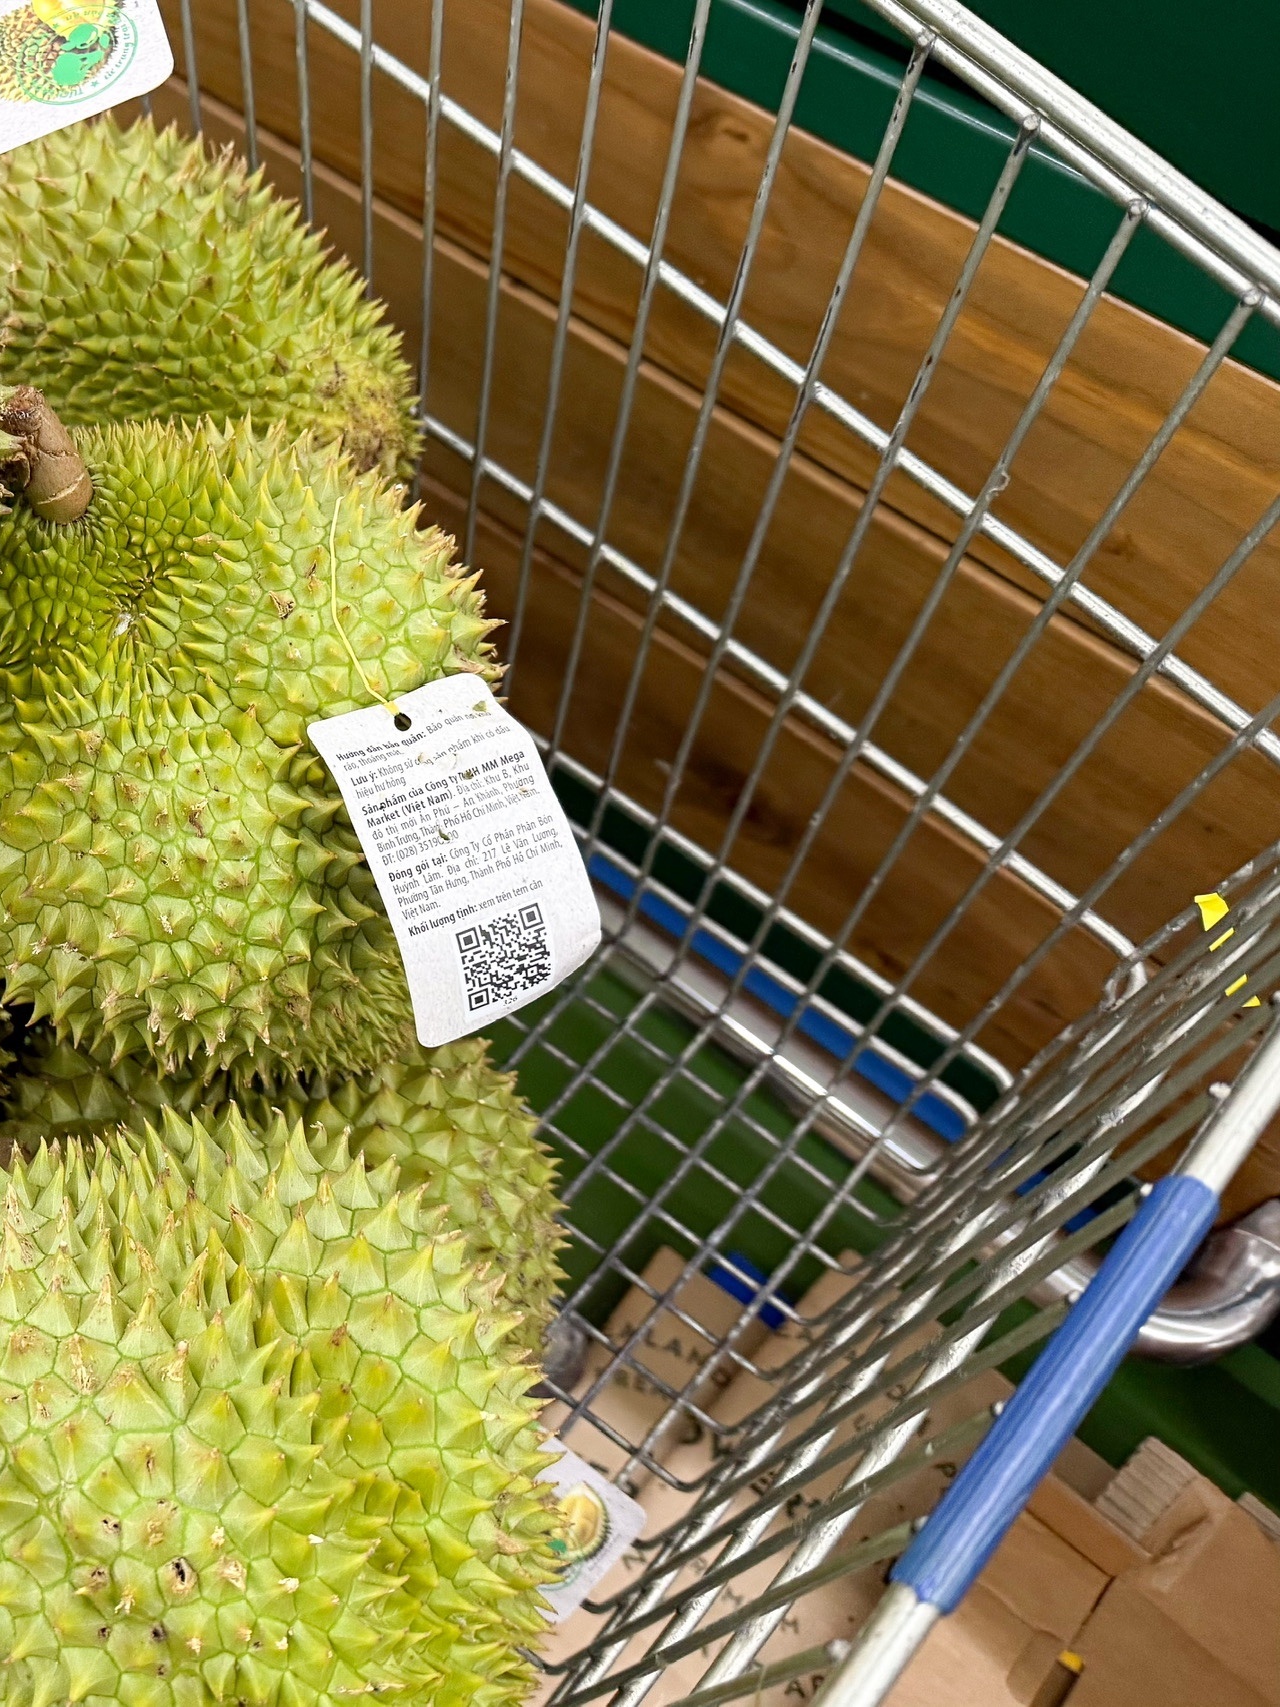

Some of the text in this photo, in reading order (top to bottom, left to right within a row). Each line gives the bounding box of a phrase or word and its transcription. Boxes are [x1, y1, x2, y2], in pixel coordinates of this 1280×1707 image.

[423, 777, 449, 793] Công
[480, 758, 499, 773] MM
[498, 749, 525, 767] Mega
[365, 808, 400, 828] Market
[426, 788, 456, 806] Nam).
[448, 844, 470, 860] Công
[481, 847, 497, 862] 217
[477, 898, 495, 910] xem
[511, 884, 528, 897] tem
